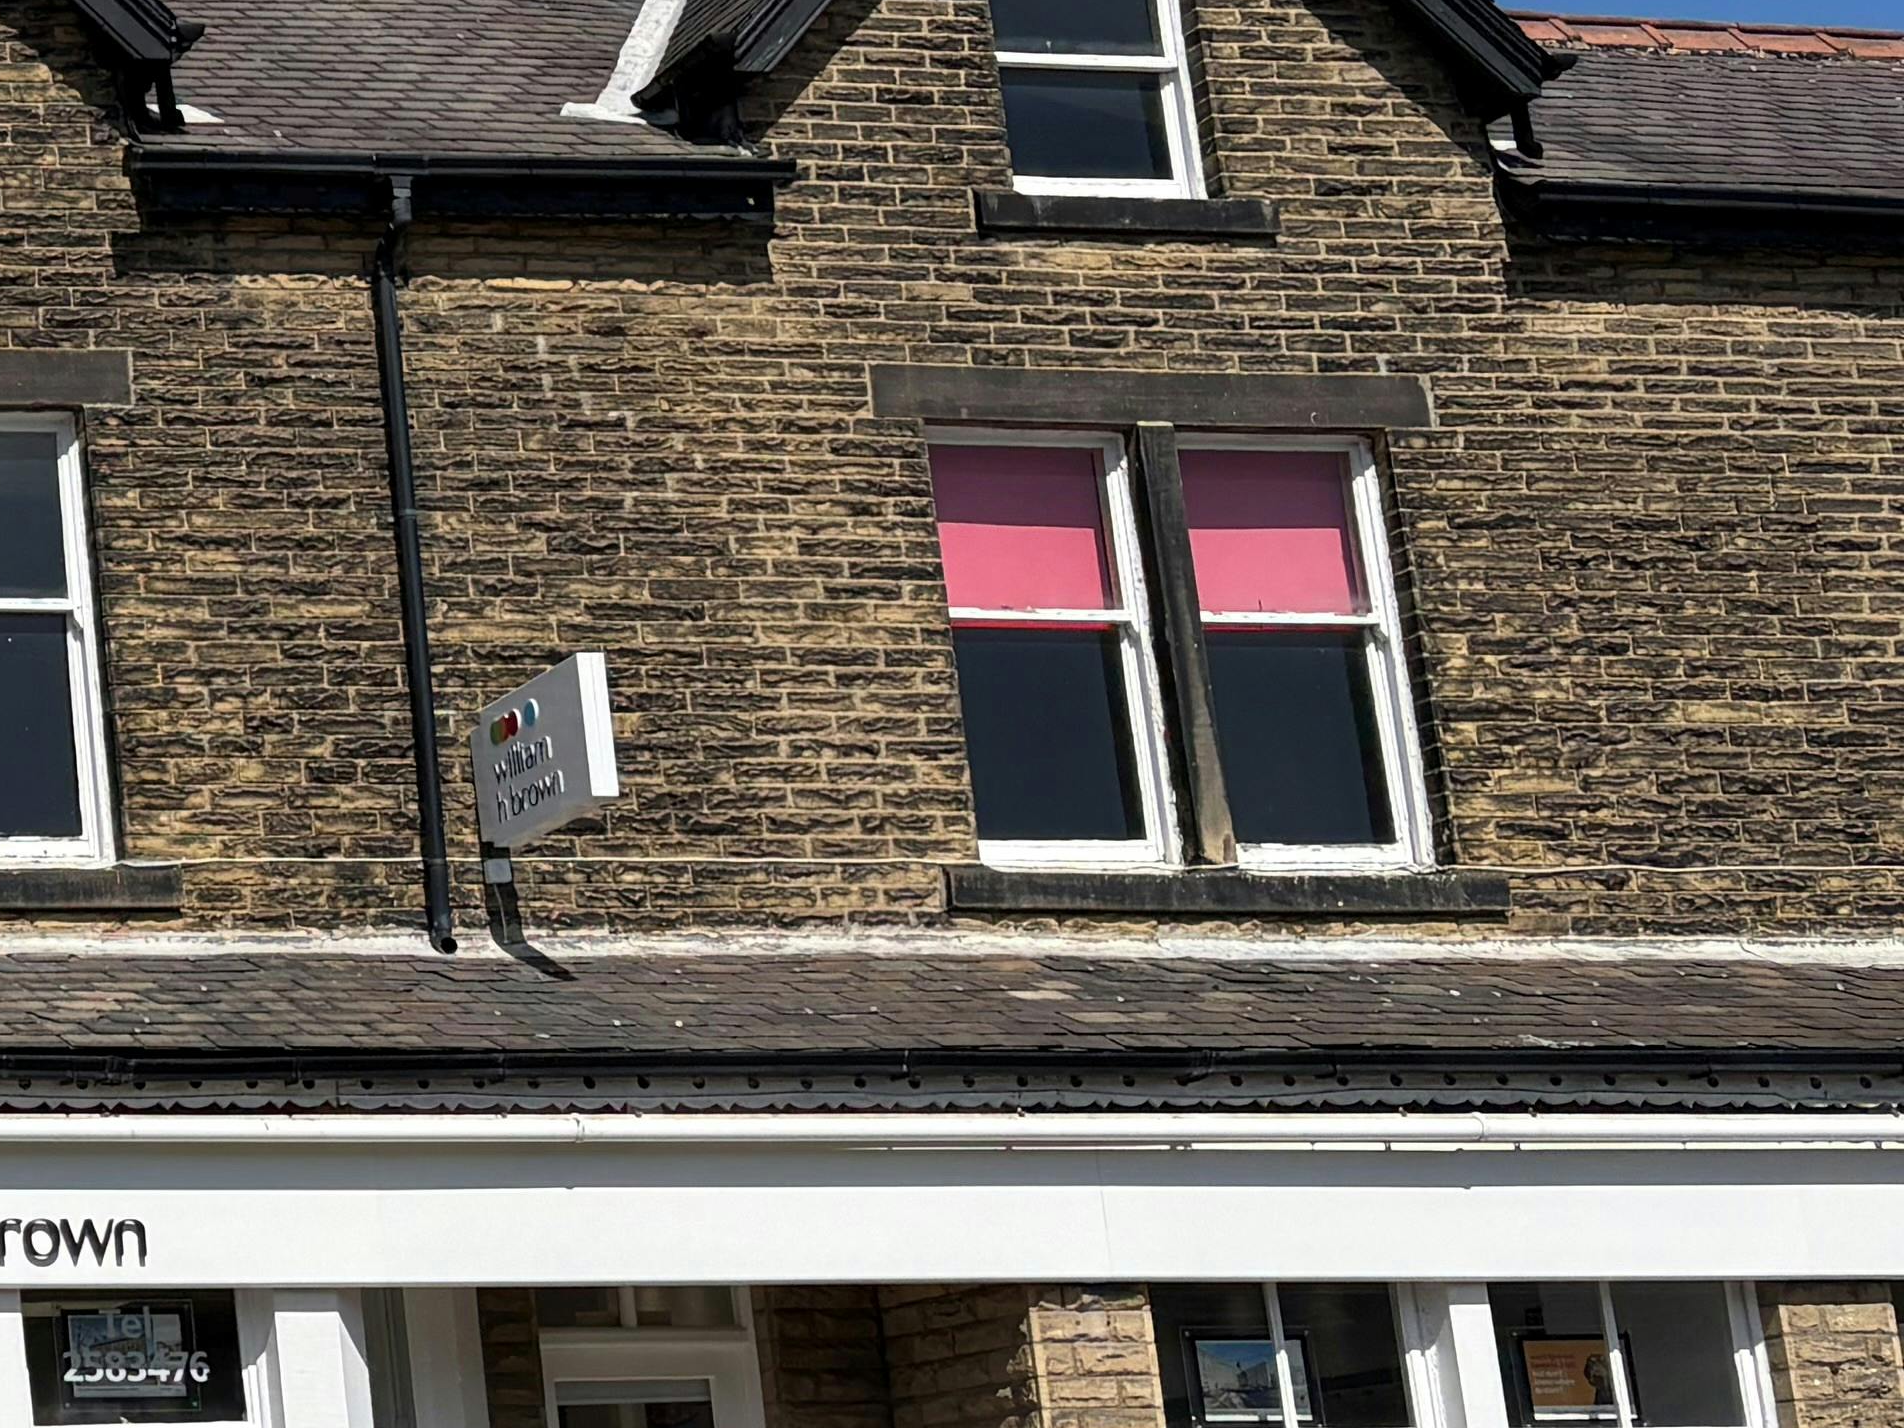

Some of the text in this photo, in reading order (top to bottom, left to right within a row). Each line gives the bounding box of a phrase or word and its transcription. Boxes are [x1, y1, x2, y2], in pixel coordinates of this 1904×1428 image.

[494, 736, 552, 785] william
[496, 770, 565, 824] h brown
[99, 1306, 154, 1339] Tel
[63, 1350, 210, 1383] 2583476
